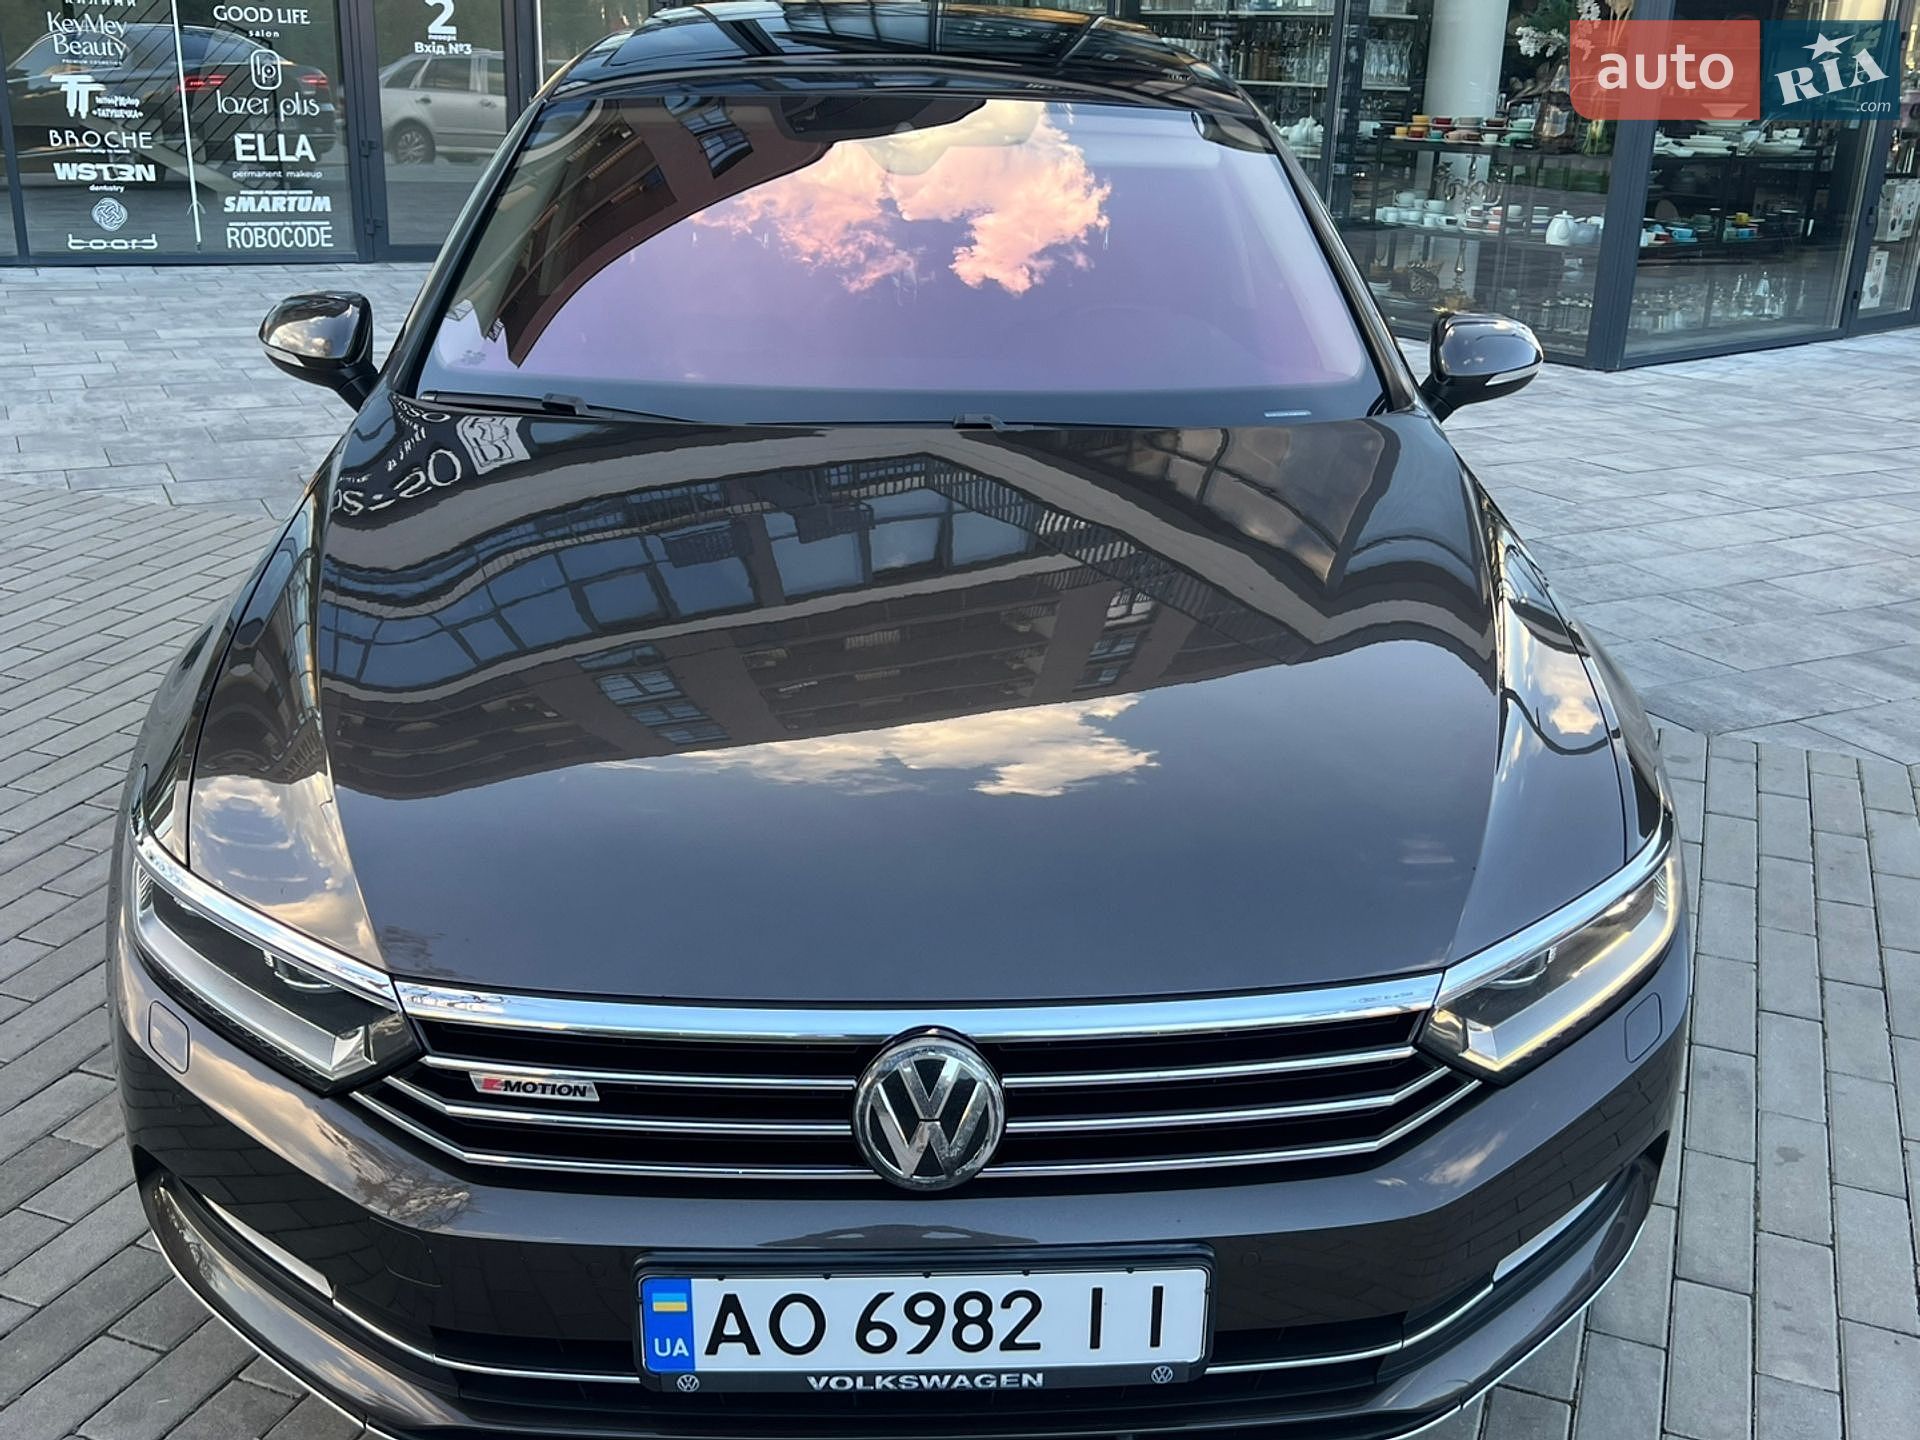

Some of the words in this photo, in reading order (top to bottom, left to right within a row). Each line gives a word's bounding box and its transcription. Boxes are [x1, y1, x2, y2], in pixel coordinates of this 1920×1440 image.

[47, 11, 127, 38] KeyMey
[213, 5, 274, 23] GOOD
[277, 8, 311, 25] LIFE
[425, 0, 457, 34] 2
[248, 29, 280, 38] salon
[53, 33, 126, 62] Beauty
[414, 41, 446, 55] Вхід
[216, 89, 269, 115] lazer
[279, 91, 320, 122] plus
[49, 129, 153, 149] BROCHE
[234, 133, 316, 162] ELLA
[232, 171, 282, 179] permanent
[286, 171, 323, 179] makeup
[89, 184, 125, 193] dentistry
[224, 196, 332, 212] SMARTUM
[226, 227, 334, 249] ROBOCODE
[704, 1292, 827, 1356] AO
[855, 1289, 1042, 1354] 6982
[654, 1337, 689, 1357] UA
[807, 1372, 1044, 1391] VOLKSWAGEN
